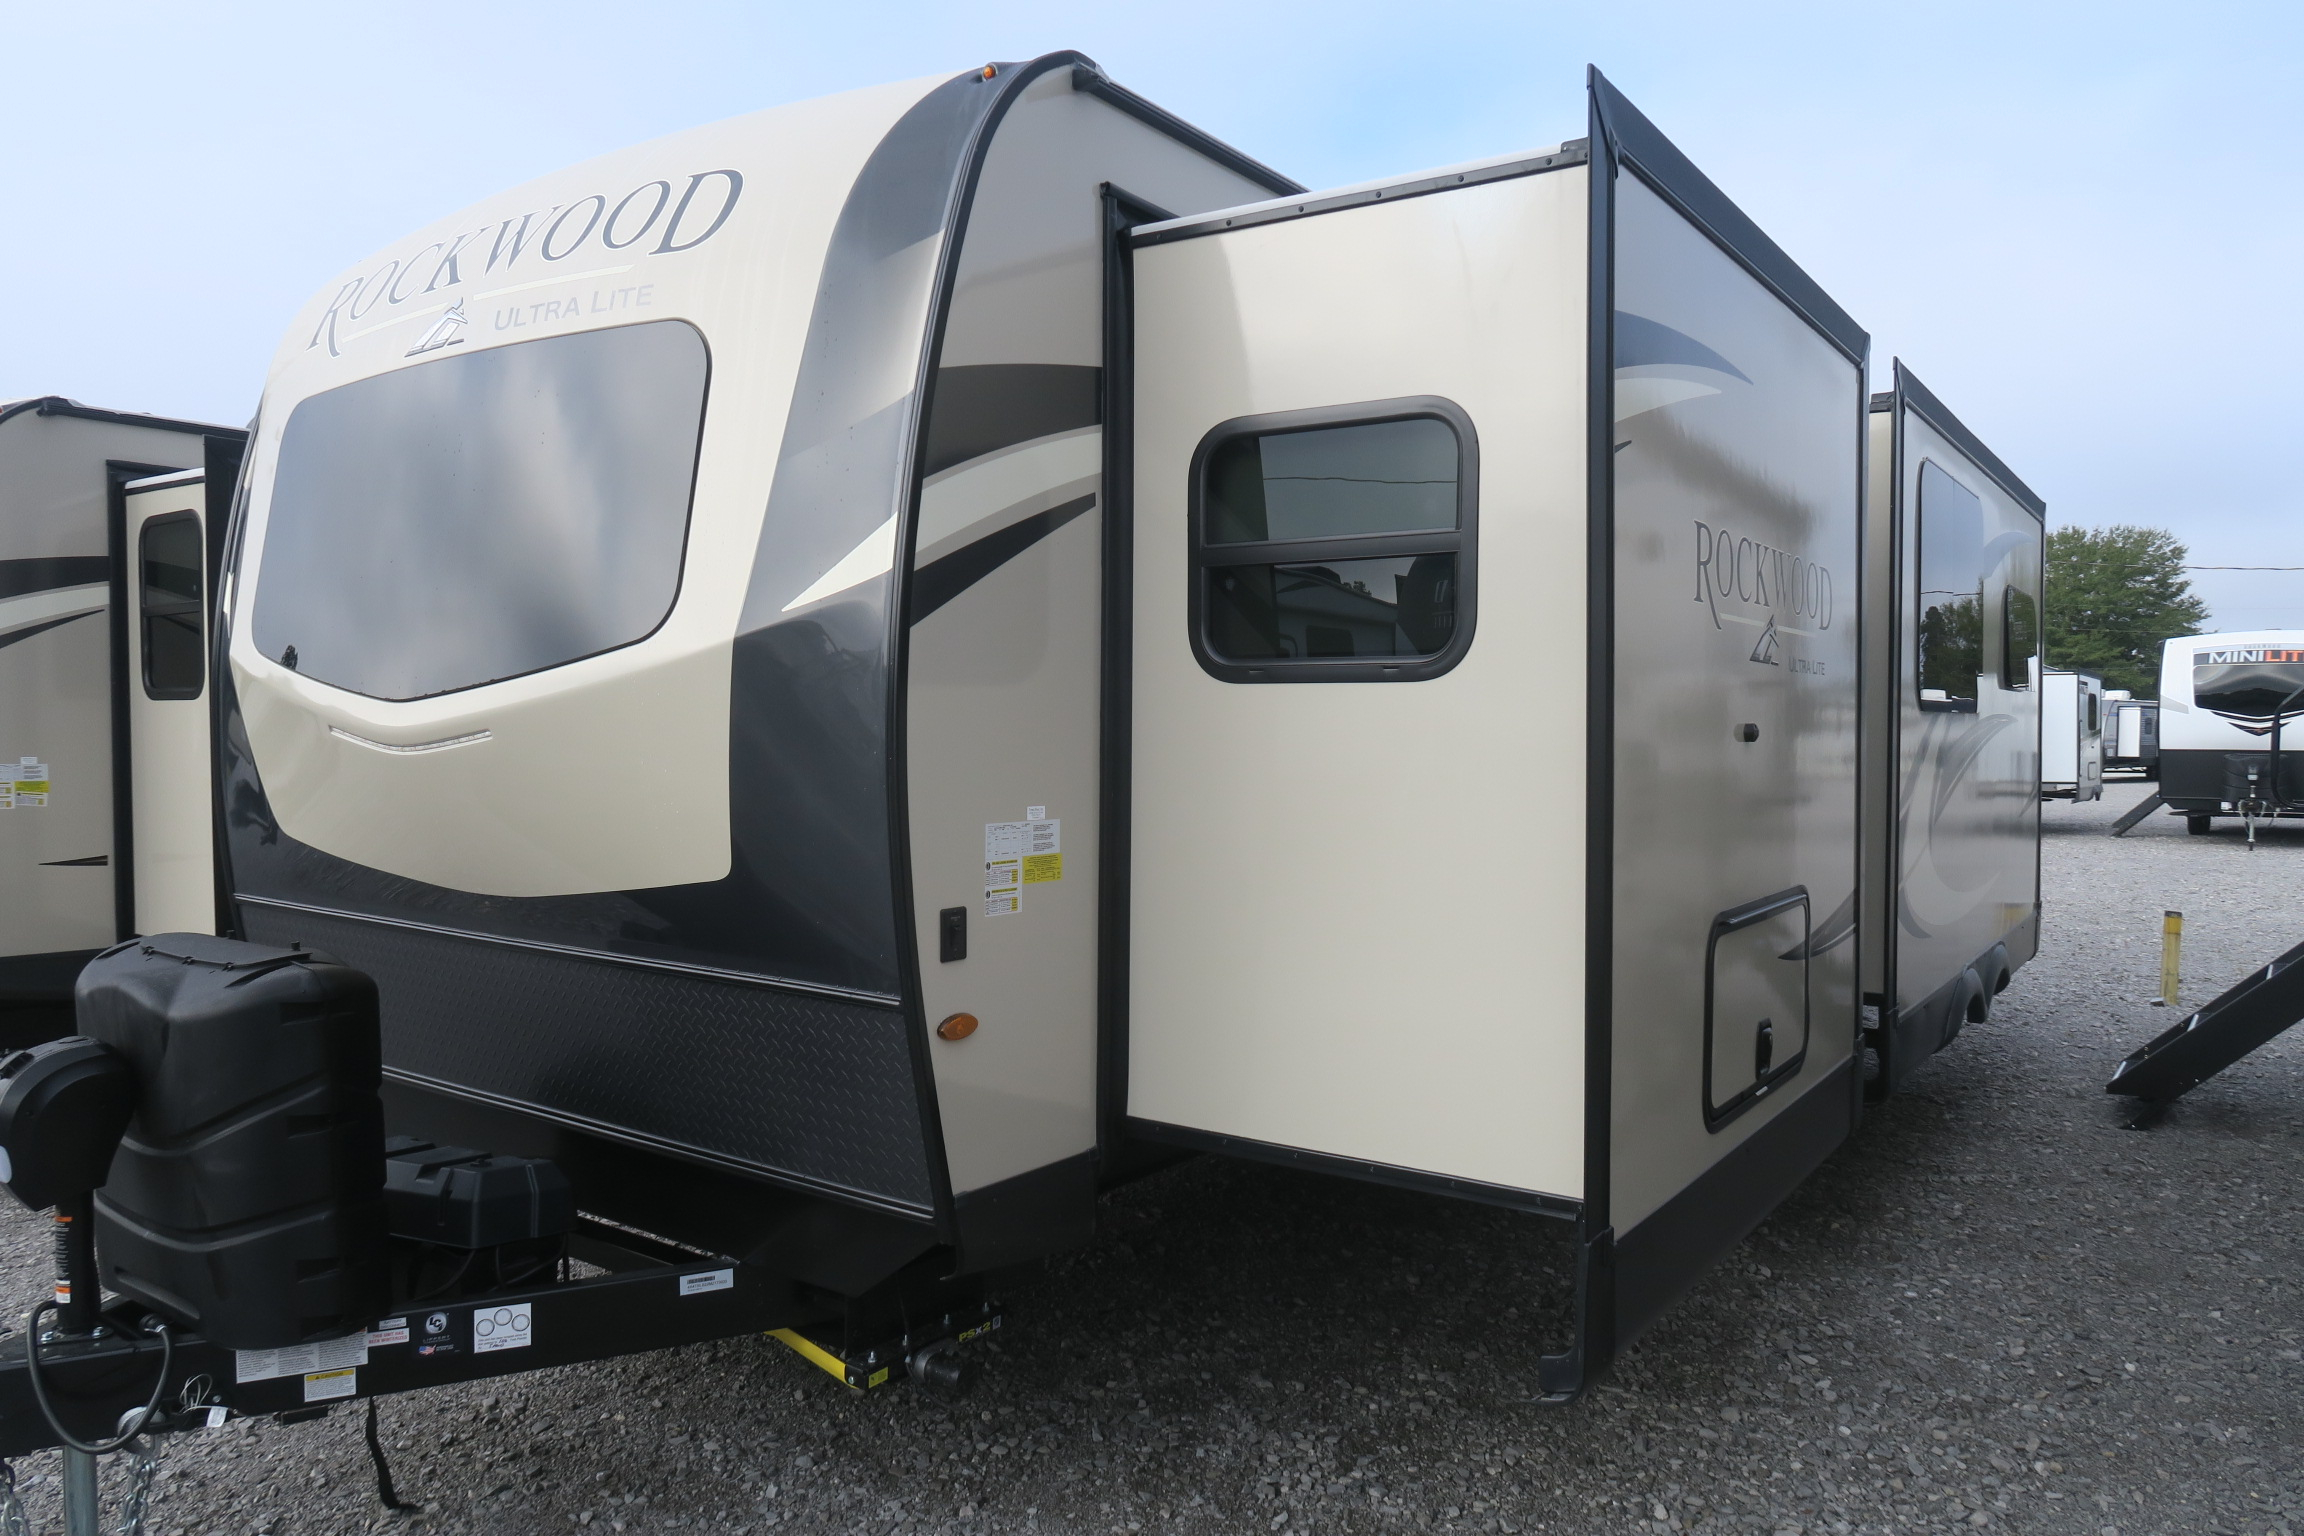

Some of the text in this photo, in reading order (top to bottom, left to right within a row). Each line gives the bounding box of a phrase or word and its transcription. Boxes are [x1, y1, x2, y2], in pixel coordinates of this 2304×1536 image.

[305, 168, 745, 358] ROCKWOOD
[494, 284, 655, 331] ULTRA LITE
[1693, 519, 1833, 631] ROCKWOOD
[1788, 656, 1825, 676] ULTRA LITE
[2209, 650, 2304, 664] MINILIT
